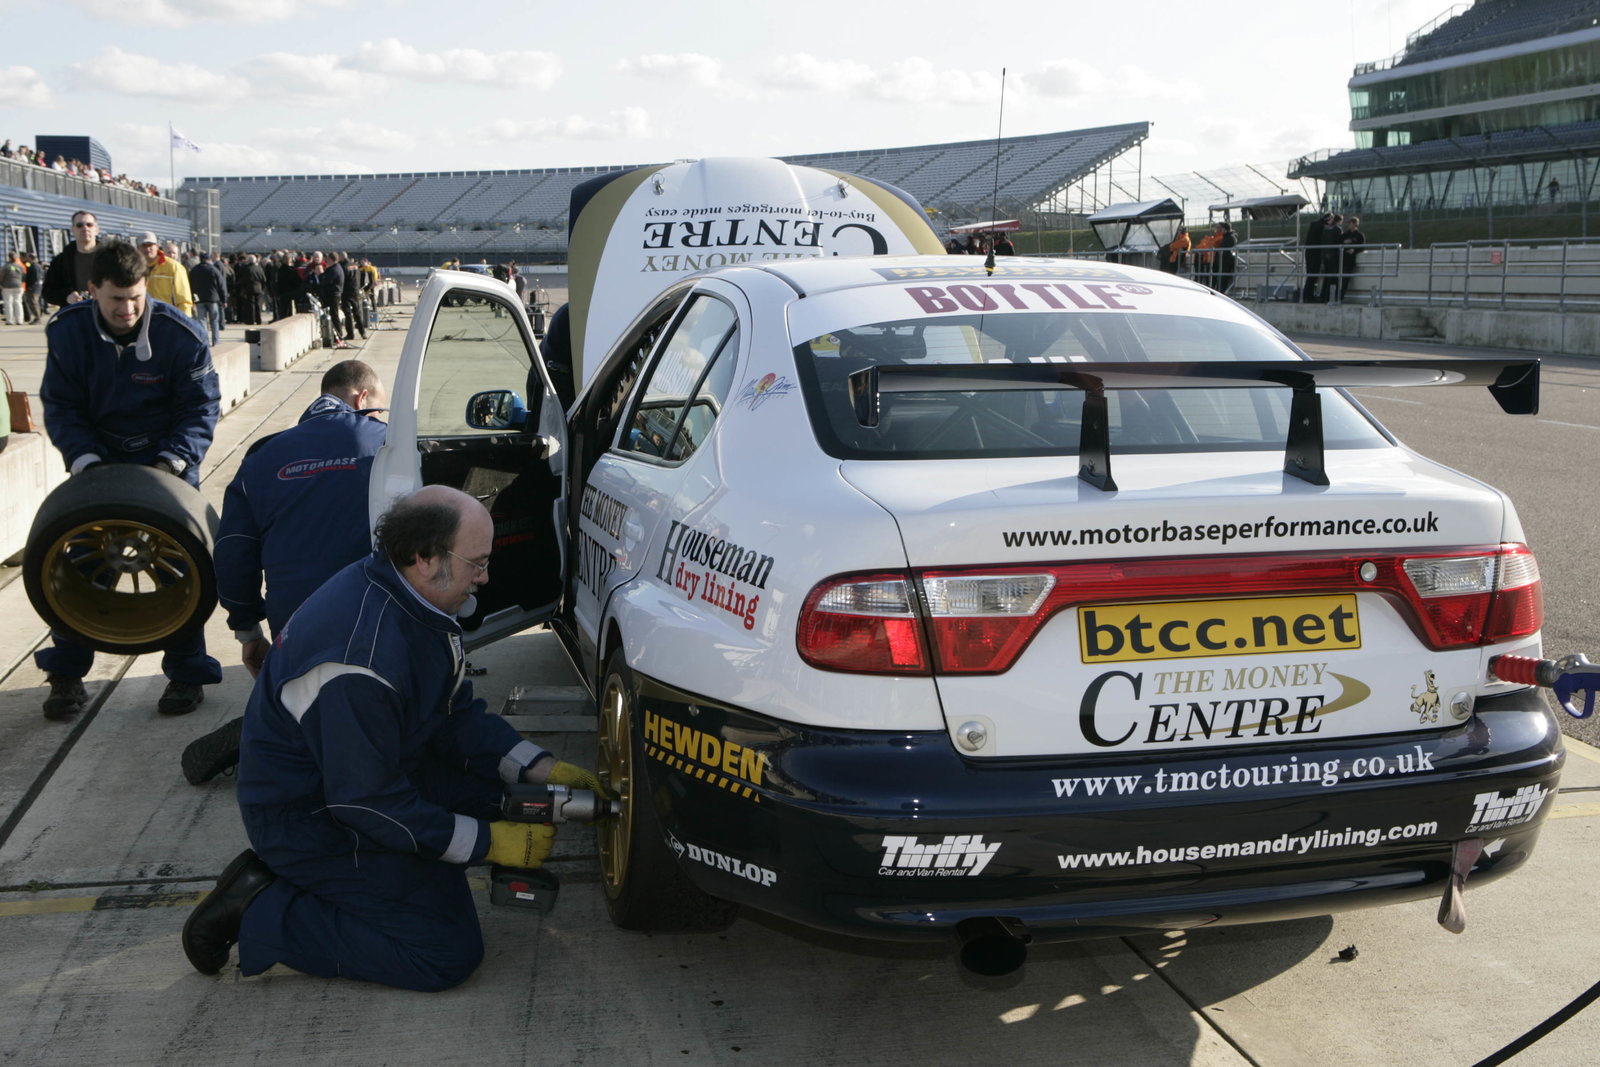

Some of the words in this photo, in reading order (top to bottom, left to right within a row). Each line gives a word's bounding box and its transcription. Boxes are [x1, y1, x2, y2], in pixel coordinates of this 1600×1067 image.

[645, 207, 678, 217] easy
[682, 207, 723, 217] made
[727, 203, 803, 215] mortgages
[642, 218, 889, 256] CENTRE
[904, 283, 1138, 314] BOTTLE
[285, 457, 358, 476] MOTORBASE
[1002, 511, 1439, 548] www.motorbaseperformance.co.uk
[656, 519, 775, 590] Houseman
[675, 561, 701, 601] dry
[700, 571, 760, 631] lining
[1082, 603, 1357, 657] btcc.net
[1153, 669, 1216, 696] THE
[1221, 662, 1329, 692] MONEY
[1078, 670, 1326, 748] CENTRE
[644, 709, 767, 786] HEWDEN
[1051, 744, 1435, 799] www.tmctouring.co.uk
[1469, 782, 1549, 825] Thrifty
[686, 842, 777, 888] DUNLOP
[880, 834, 1002, 877] Thrifty
[1056, 820, 1439, 870] www.housemandrylining.com
[878, 866, 895, 876] Car
[896, 868, 917, 877] and
[916, 868, 934, 877] Van
[934, 867, 969, 877] Rental
